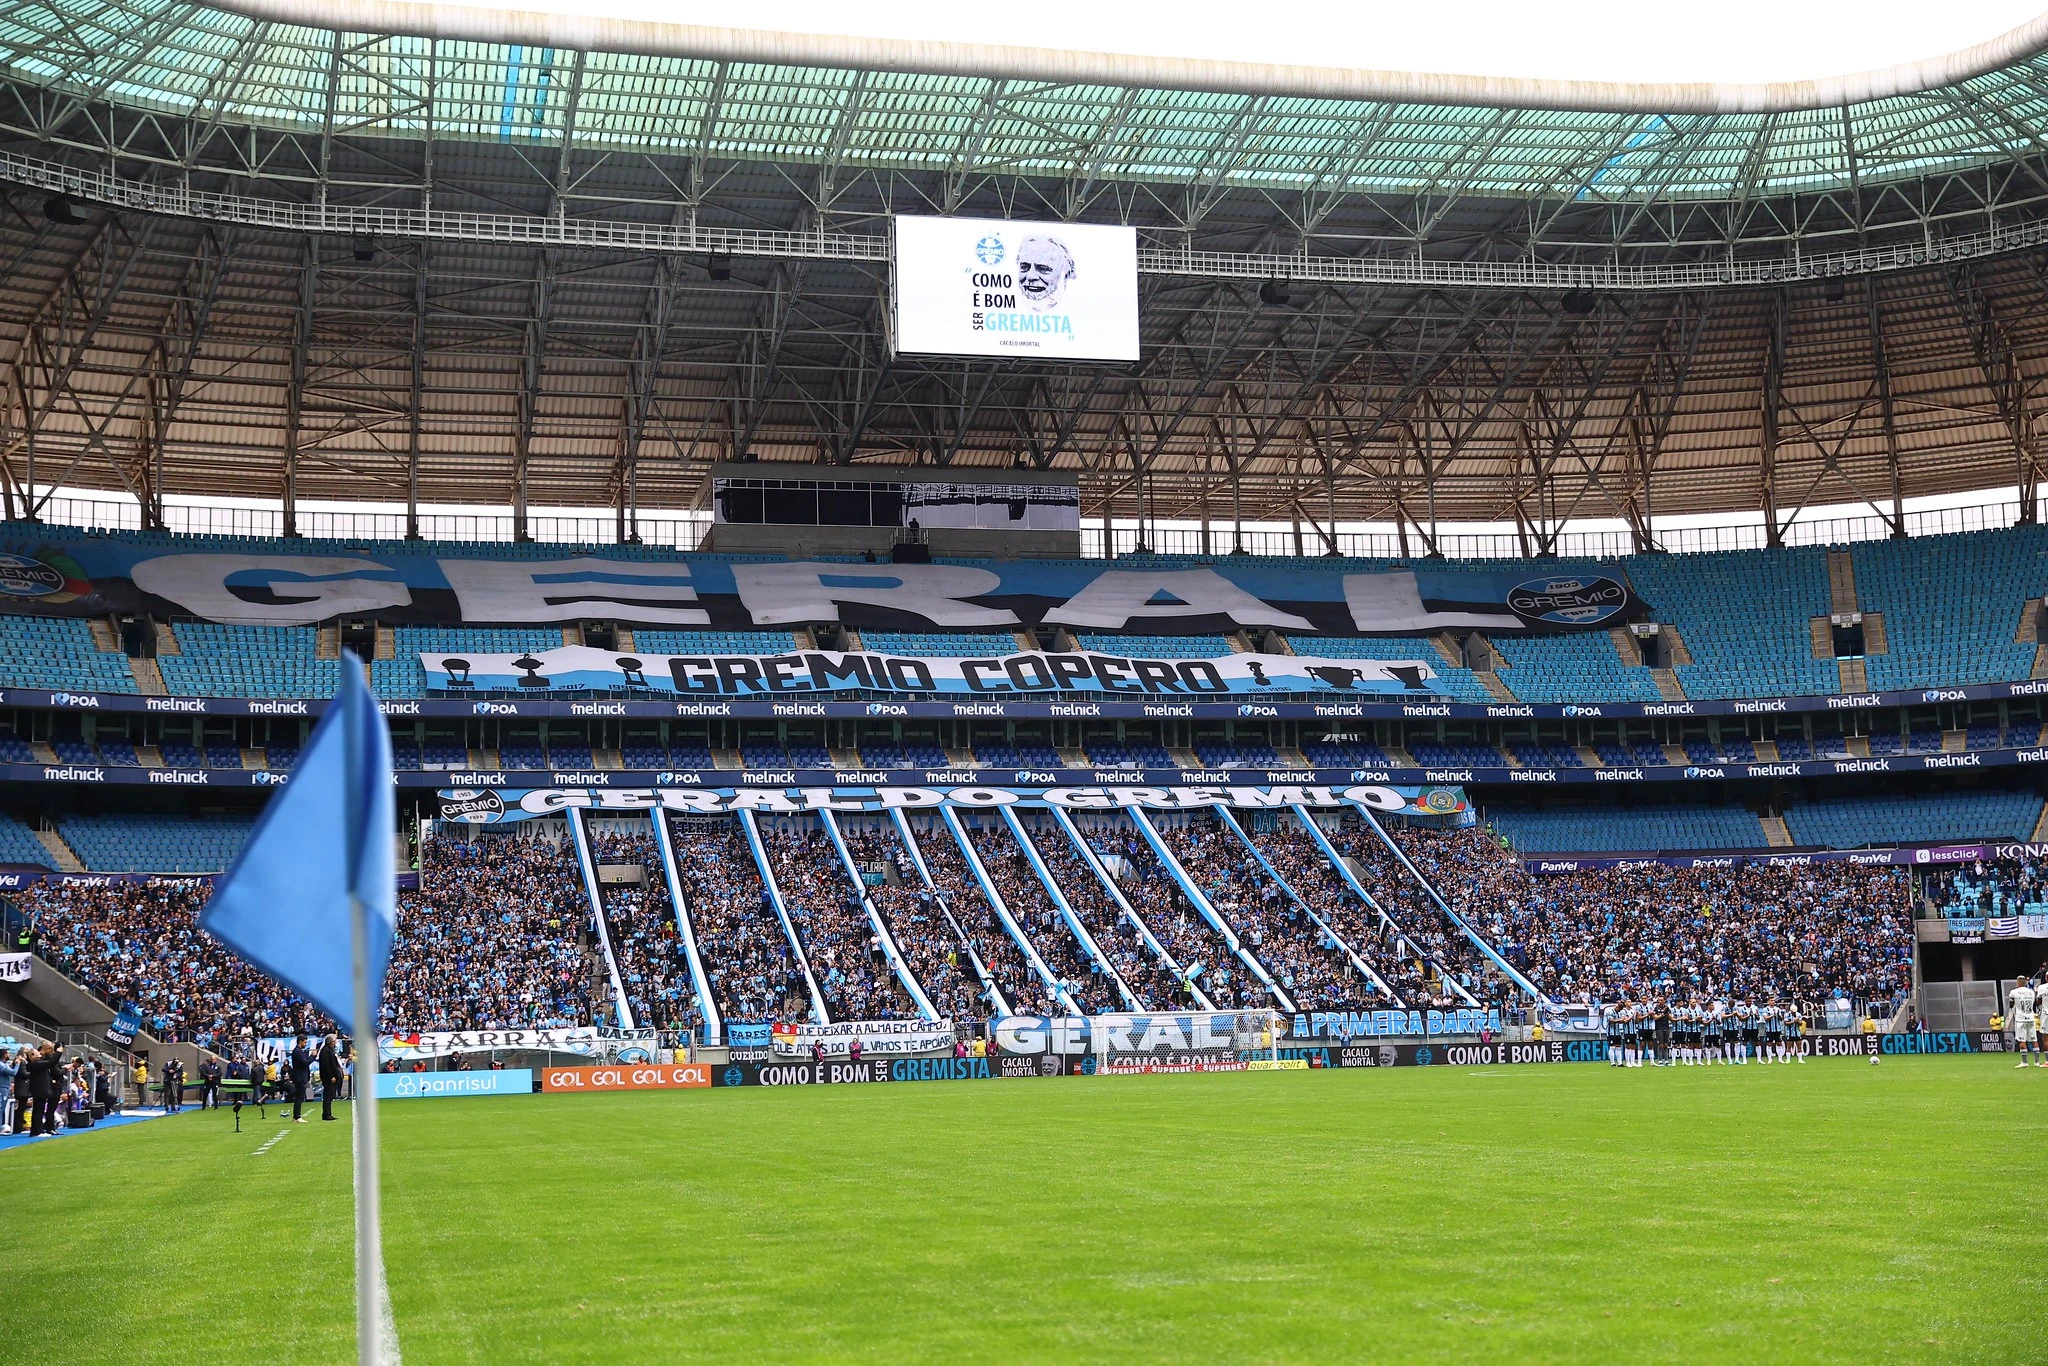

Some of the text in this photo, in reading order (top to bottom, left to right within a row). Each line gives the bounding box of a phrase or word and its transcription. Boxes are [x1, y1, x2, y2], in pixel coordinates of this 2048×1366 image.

[972, 273, 1012, 288] COMO
[973, 290, 1016, 309] É BOM
[973, 312, 984, 331] SER
[130, 553, 1526, 631] GERAL
[1548, 581, 1579, 590] 1903
[960, 655, 1229, 694] COPERO
[146, 695, 205, 711] melnick
[248, 697, 308, 713] melnick
[379, 701, 420, 714] elnick
[571, 699, 625, 714] melnick
[677, 700, 732, 715] melnick
[953, 700, 1004, 715] melnick
[1050, 700, 1102, 715] melnick
[1644, 700, 1694, 715] melnick
[1734, 699, 1786, 712] melnick
[1827, 692, 1880, 708] melnick
[773, 702, 827, 715] melnick
[1144, 700, 1193, 716] melnick
[1315, 701, 1362, 715] melnick
[1403, 701, 1450, 715] melnick
[1487, 702, 1533, 716] melnick
[1833, 759, 1890, 772] melnick
[1923, 751, 1980, 767] melnick
[44, 764, 103, 781] melnick
[149, 770, 207, 783] melnick
[448, 769, 506, 784] melnick
[553, 769, 611, 784] melnick
[740, 769, 795, 783] melnick
[834, 768, 889, 783] melnick
[924, 768, 978, 782] melnick
[1093, 768, 1146, 782] melnick
[1180, 768, 1232, 782] melnick
[1266, 768, 1317, 782] melnick
[1425, 768, 1472, 781] melnick
[1510, 770, 1556, 781] melnick
[1595, 767, 1643, 780] melnick
[1748, 763, 1801, 777] melnick
[271, 775, 288, 784] PO
[456, 790, 472, 798] 1903
[520, 788, 865, 813] GERAL
[874, 787, 1020, 808] DO
[441, 797, 500, 815] GRÊMIO
[1850, 853, 1892, 864] PanVel
[1932, 849, 1978, 860] lessClick
[1540, 862, 1578, 872] PanVel
[811, 1024, 853, 1036] DEIXAR
[864, 1023, 892, 1033] ALMA
[893, 1023, 907, 1033] EM
[1311, 1010, 1424, 1037] PRIMEIRA
[1427, 1008, 1501, 1035] BARRA
[413, 1029, 559, 1053] GARRA
[597, 1028, 655, 1041] RASTA
[996, 1015, 1232, 1054] GERAL
[774, 1043, 794, 1053] QUE
[830, 1042, 845, 1053] DO
[870, 1040, 901, 1051] VAMOS
[904, 1040, 918, 1050] TE
[919, 1035, 951, 1049] APOIAR
[1816, 1036, 1862, 1056] É BOM
[1867, 1034, 1878, 1054] SER
[1882, 1033, 1971, 1054] GREMISTA
[730, 1050, 768, 1061] QUERIDO
[1341, 1048, 1370, 1058] CACALO
[1447, 1047, 1492, 1065] COMO
[1498, 1043, 1506, 1063] É
[1512, 1045, 1547, 1063] BOM
[1551, 1041, 1563, 1063] SER
[893, 1057, 990, 1081] GREMISTA
[1001, 1058, 1032, 1067] CACALO
[1151, 1064, 1196, 1073] SUPERBET
[1203, 1062, 1247, 1072] SUPERBET
[1250, 1060, 1302, 1071] quarzolit
[1341, 1057, 1376, 1067] IMORTAL
[550, 1068, 706, 1087] GOL GOL GOL GOL
[759, 1062, 870, 1086] COMO É BOM
[875, 1060, 888, 1081] SER
[1001, 1067, 1038, 1077] IMORTAL
[419, 1075, 497, 1093] banrisul
